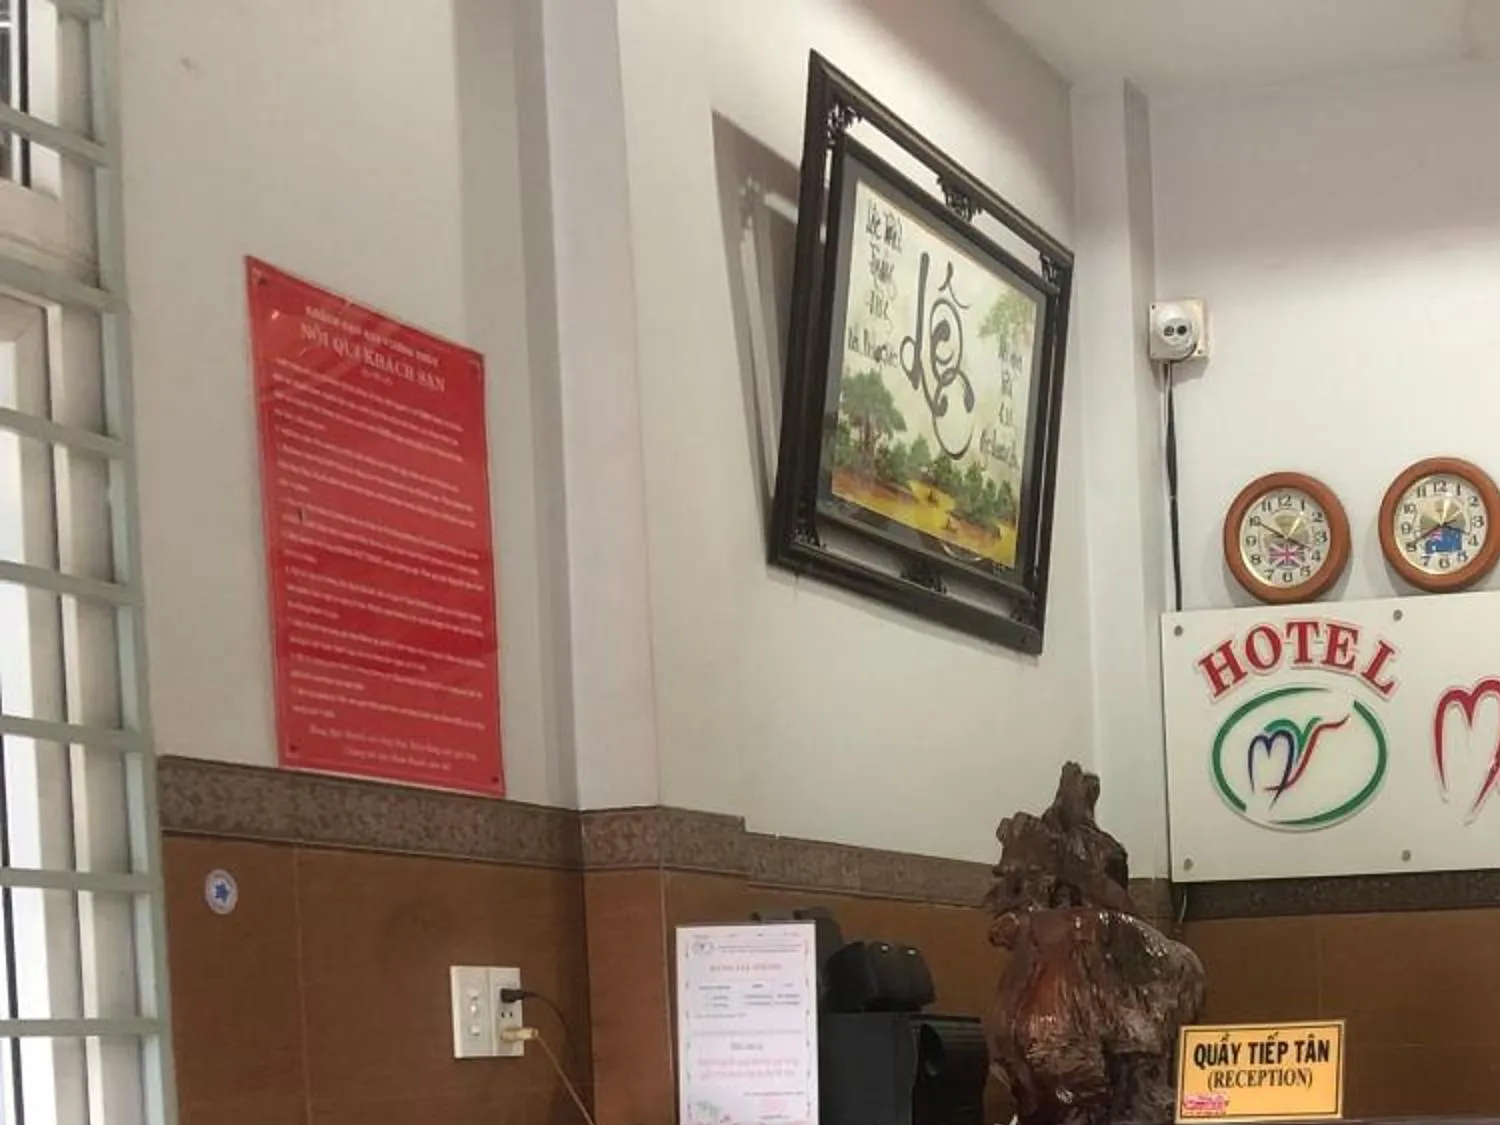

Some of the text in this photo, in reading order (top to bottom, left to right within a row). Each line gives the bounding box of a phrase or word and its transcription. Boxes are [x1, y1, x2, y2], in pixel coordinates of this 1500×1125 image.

[1197, 619, 1397, 699] HOTEL
[1248, 1031, 1288, 1065] TIẾP
[1294, 1033, 1330, 1063] TÂN
[1207, 1067, 1313, 1091] (RECEPTION)
